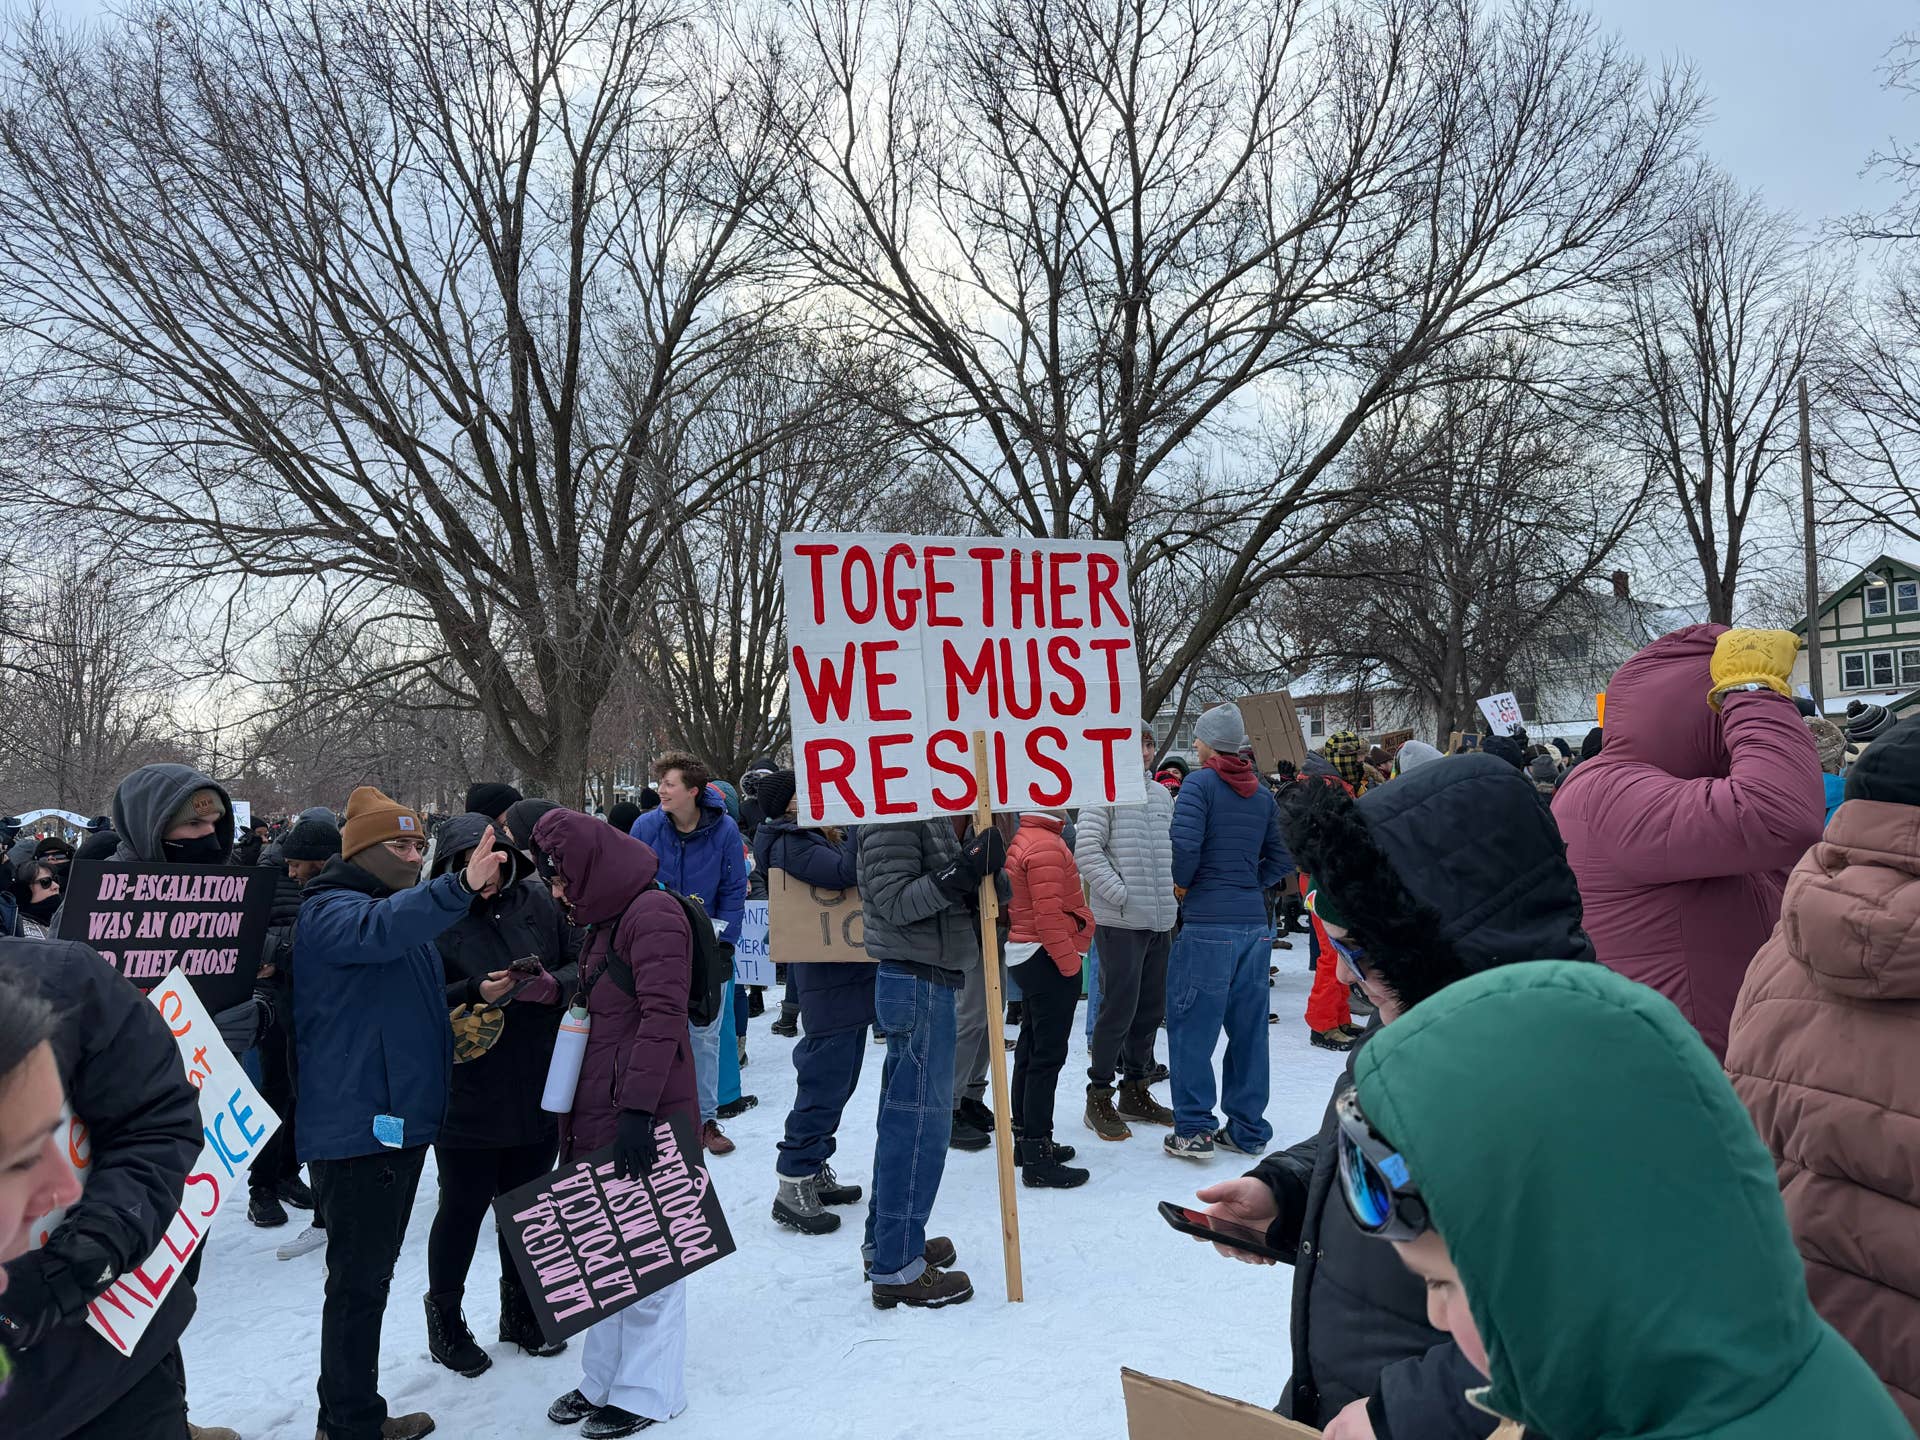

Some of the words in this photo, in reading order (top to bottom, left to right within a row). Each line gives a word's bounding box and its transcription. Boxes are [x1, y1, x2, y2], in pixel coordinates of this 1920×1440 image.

[794, 543, 1131, 631] TOGETHER
[793, 640, 912, 724] WE
[943, 636, 1131, 721] MUST
[805, 726, 1133, 821] RESIST
[97, 873, 249, 903] DE-ESCALATION
[88, 911, 134, 940] WAS
[136, 911, 168, 939] AN
[169, 911, 244, 939] OPTION
[123, 949, 178, 978] THEY
[179, 949, 239, 977] CHOSE
[203, 1087, 266, 1178] ICE
[513, 1193, 583, 1289] MIGRA,
[630, 1236, 674, 1278] LA
[545, 1277, 595, 1323] LA
[592, 1265, 638, 1309] LA
